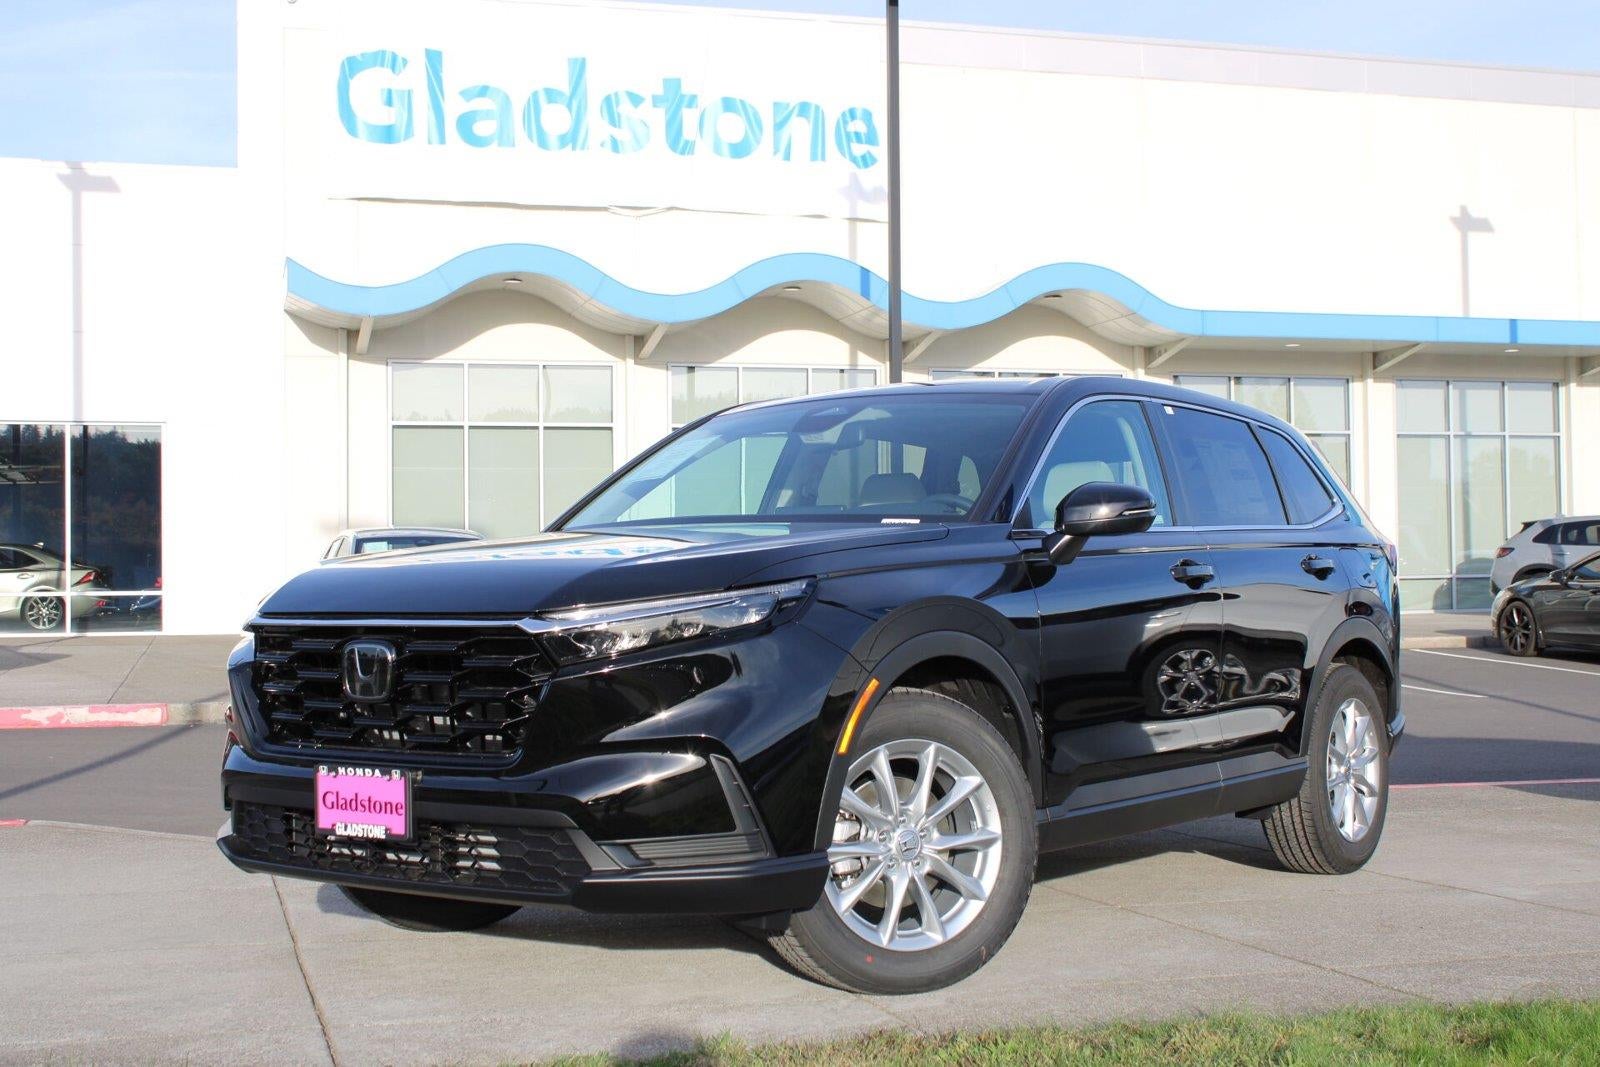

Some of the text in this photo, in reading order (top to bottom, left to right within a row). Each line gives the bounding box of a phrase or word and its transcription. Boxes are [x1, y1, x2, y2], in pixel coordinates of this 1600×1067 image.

[337, 48, 880, 170] Gladstone
[337, 766, 382, 777] HONDA
[322, 790, 404, 816] Gladstone
[335, 822, 386, 839] GLADSTONE
